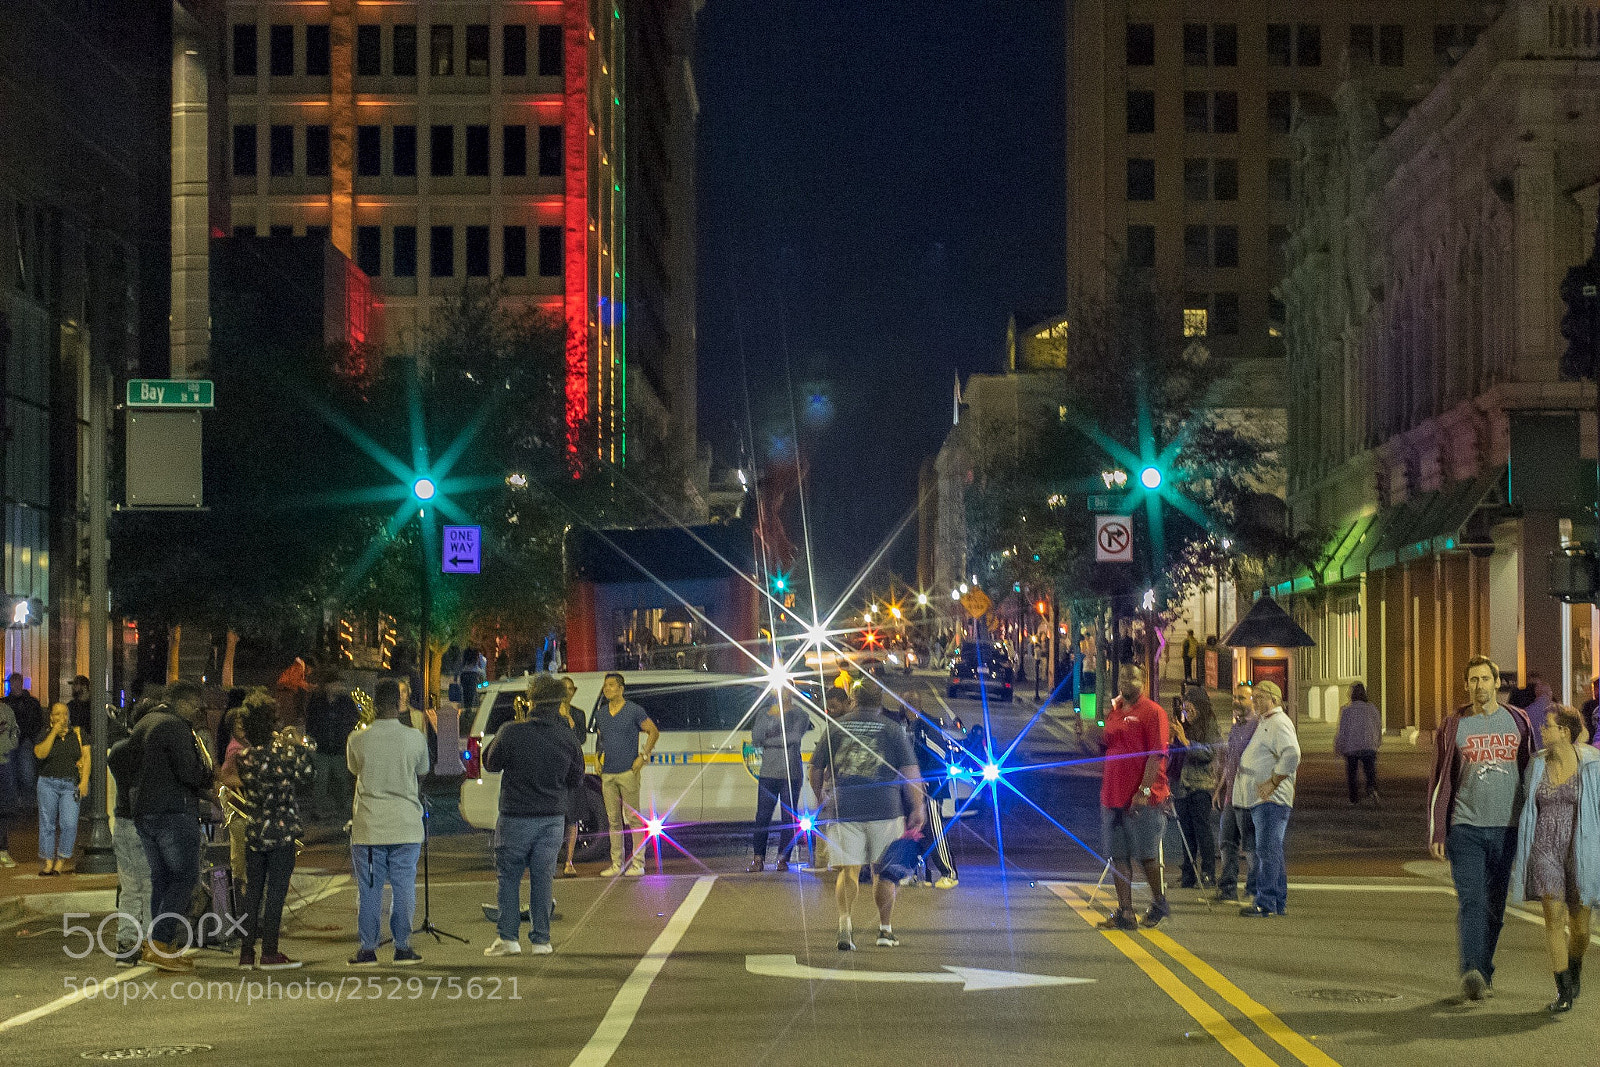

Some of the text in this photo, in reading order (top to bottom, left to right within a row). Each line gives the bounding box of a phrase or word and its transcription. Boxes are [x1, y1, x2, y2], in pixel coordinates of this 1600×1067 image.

[141, 383, 165, 404] Bay
[450, 530, 473, 541] ONE
[451, 542, 474, 552] WAY
[1461, 733, 1519, 750] STAR
[1462, 748, 1518, 763] WARS
